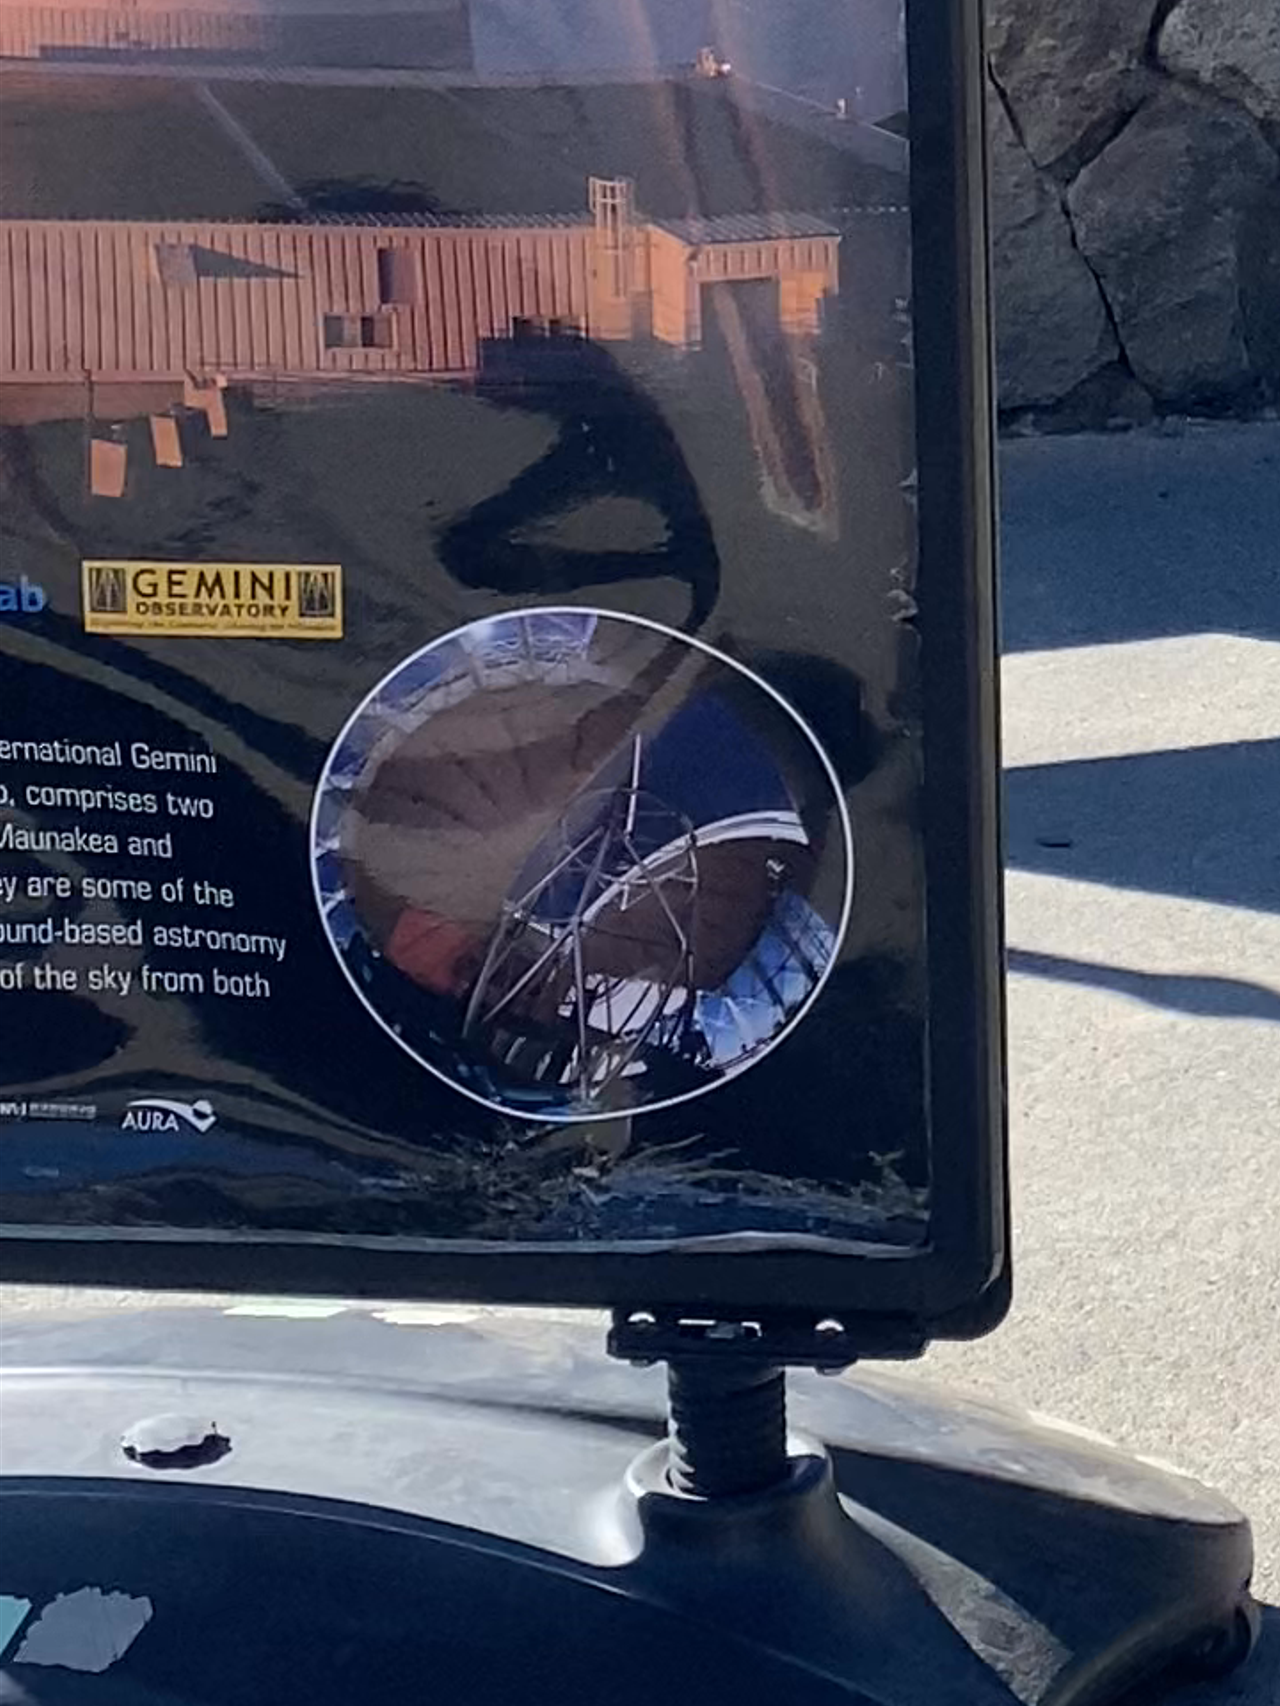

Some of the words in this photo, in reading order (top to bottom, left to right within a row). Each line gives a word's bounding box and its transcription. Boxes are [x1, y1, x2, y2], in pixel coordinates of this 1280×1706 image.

[132, 568, 292, 601] GEMINI
[136, 602, 289, 619] OBSERVATORY
[131, 742, 217, 773] Gemini
[26, 785, 157, 813] comprises
[167, 793, 214, 819] two
[128, 833, 173, 859] and
[27, 877, 71, 898] are
[82, 877, 152, 901] some
[161, 878, 184, 903] of
[194, 881, 235, 908] the
[0, 918, 143, 946] und-based
[153, 925, 287, 962] astronomy
[0, 962, 25, 989] of
[34, 962, 77, 990] the
[88, 963, 132, 996] sky
[141, 964, 203, 993] from
[213, 968, 271, 998] both
[122, 1111, 179, 1132] AURA
